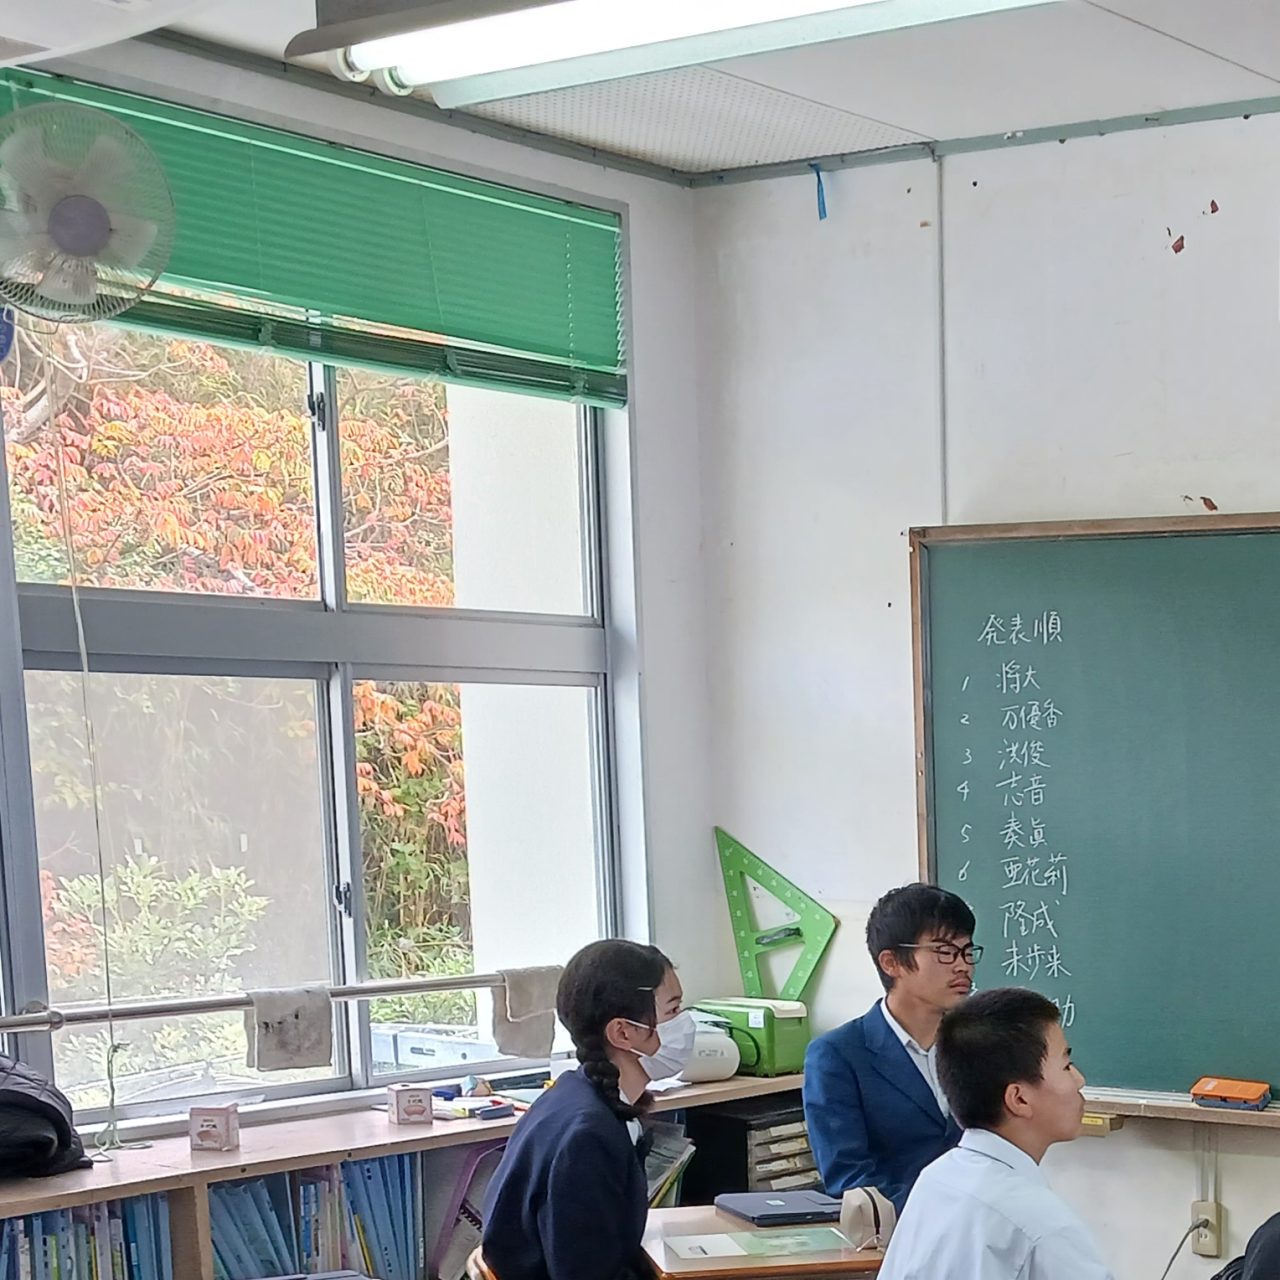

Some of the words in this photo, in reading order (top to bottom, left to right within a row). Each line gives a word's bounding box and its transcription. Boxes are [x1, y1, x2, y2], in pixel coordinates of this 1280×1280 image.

[977, 611, 1063, 646] 発表順
[960, 713, 970, 725] 2
[1000, 698, 1064, 731] 万優香
[962, 748, 973, 765] 3
[956, 780, 970, 802] 4
[961, 823, 973, 844] 5
[958, 860, 970, 882] 6
